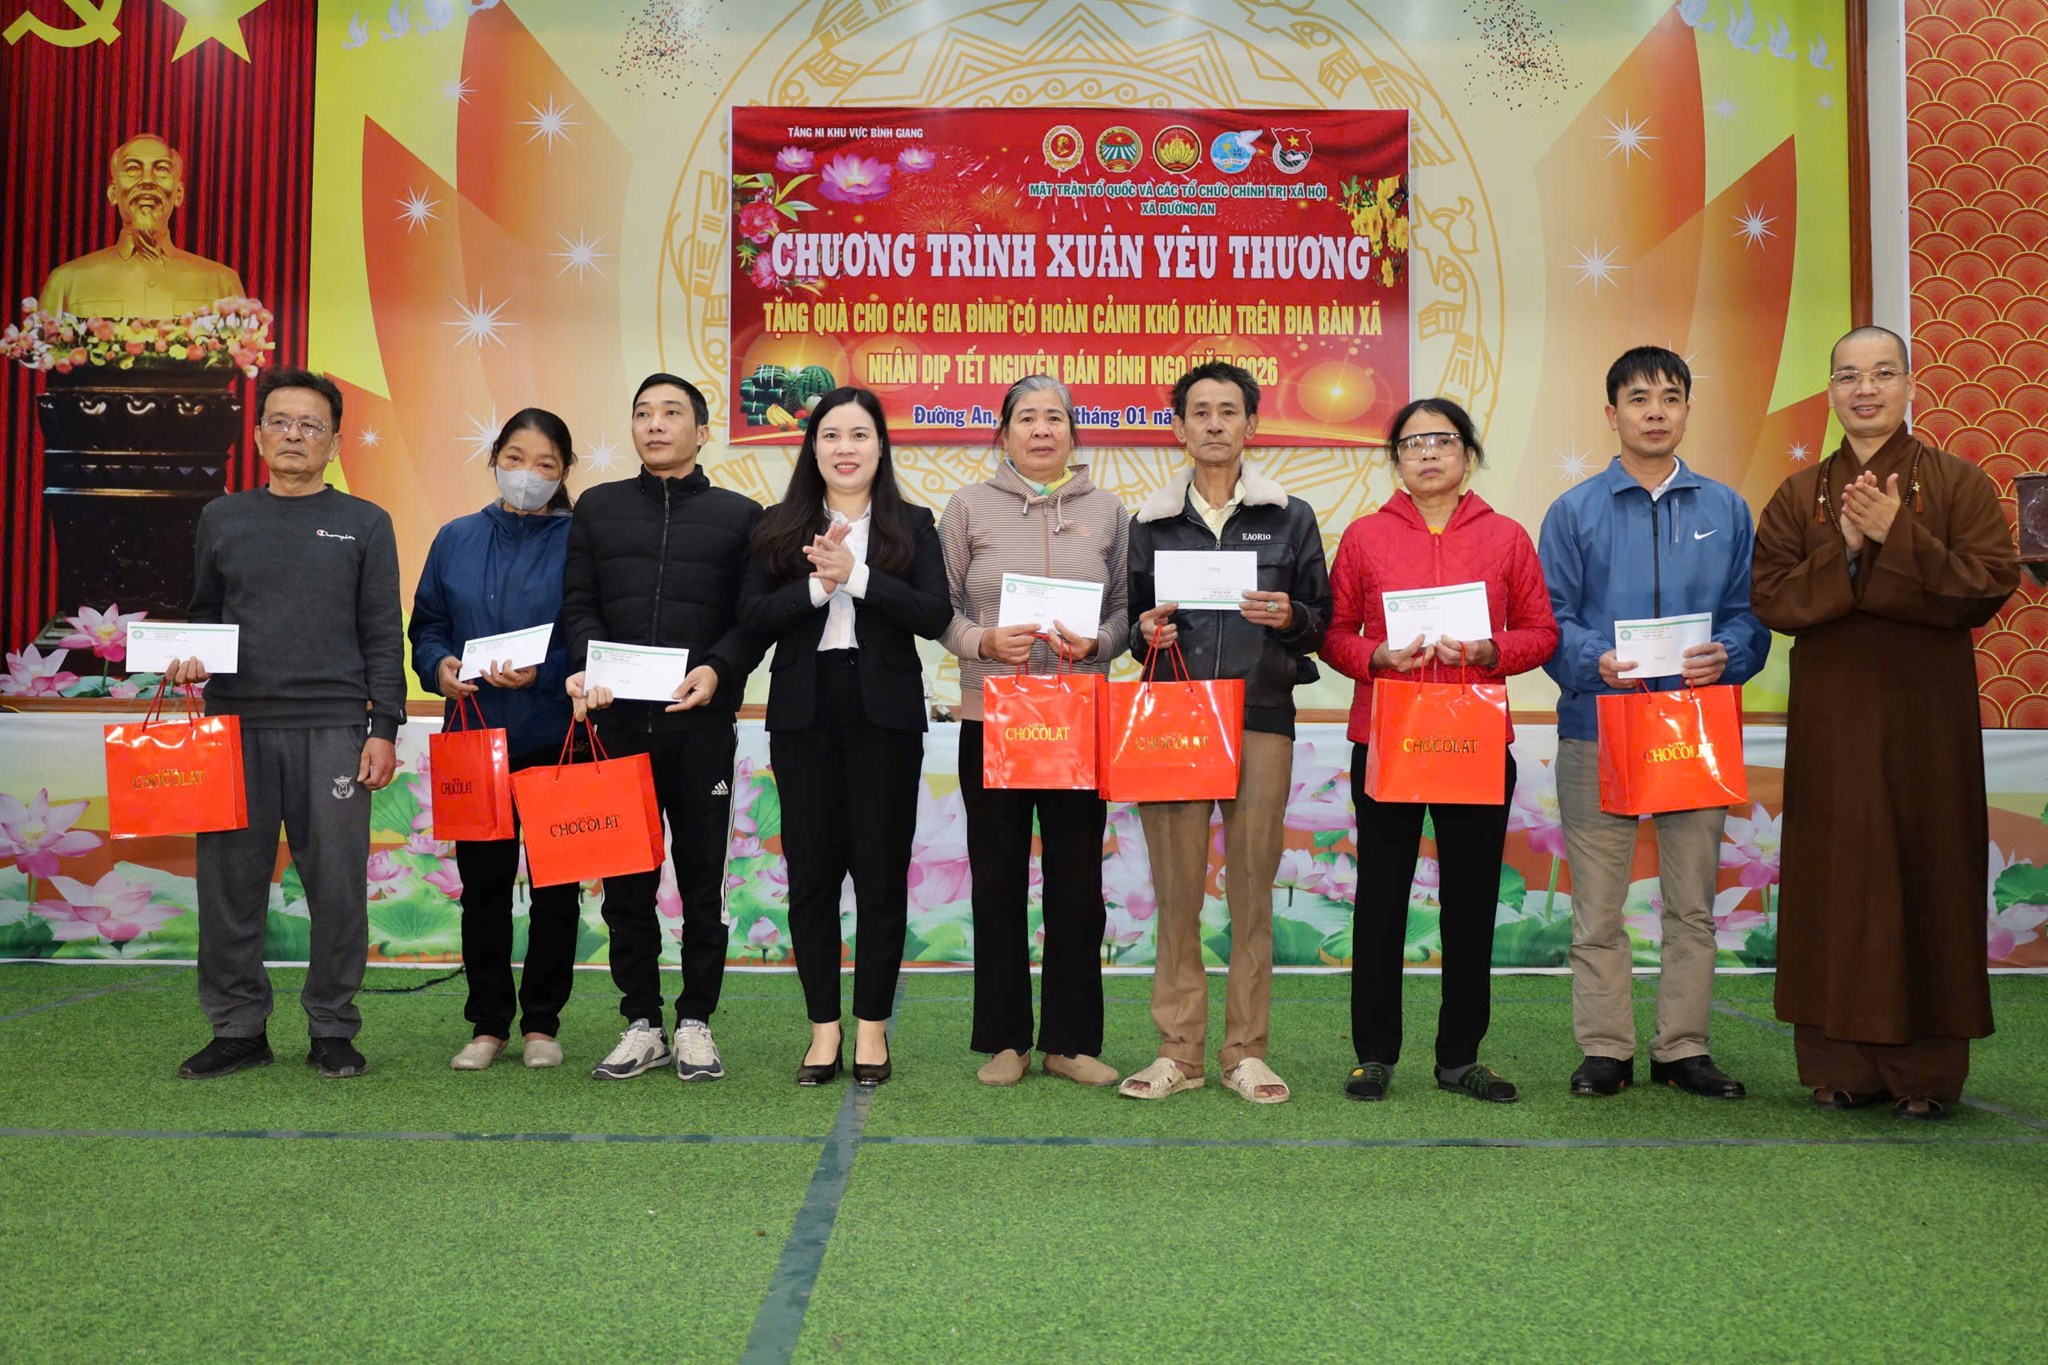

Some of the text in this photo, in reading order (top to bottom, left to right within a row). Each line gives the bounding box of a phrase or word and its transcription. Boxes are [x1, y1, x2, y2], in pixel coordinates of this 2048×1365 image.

[788, 125, 923, 140] TĂNG NI KHU VỰC BÌNH GIANG
[1055, 181, 1086, 199] TRẬN
[1088, 178, 1105, 196] TỔ
[1106, 179, 1136, 198] QUỐC
[1138, 181, 1155, 197] VÀ
[1155, 181, 1180, 197] CÁC
[1181, 179, 1197, 197] TỔ
[1198, 182, 1229, 197] CHỨC
[1231, 182, 1266, 197] CHÍNH
[1268, 184, 1287, 199] TRỊ
[1290, 183, 1305, 198] XÃ
[1307, 183, 1328, 199] HỘI
[1140, 200, 1216, 216] XÃ ĐƯỜNG AN
[772, 223, 1370, 280] CHƯƠNG TRÌNH XUÂN YÊU THƯƠNG
[763, 294, 1382, 340] TẶNG QUÀ CHO CÁC GIA ĐÌNH CÓ HOÀN CẢNH KHÓ KHĂN TRÊN ĐỊA BÀN XÃ
[868, 348, 917, 384] NHÂN
[922, 354, 950, 390] DỊP
[955, 345, 985, 384] TẾT
[990, 349, 1059, 384] NGUYÊN
[1063, 349, 1099, 384] ĐÁN
[1104, 349, 1146, 384] BÍNH
[913, 405, 998, 428] Đường An,
[1075, 405, 1120, 428] tháng
[1126, 405, 1147, 426] 01
[1004, 726, 1071, 741] CHOCOLAT
[1403, 738, 1478, 753] CHOCOLAT
[549, 814, 620, 838] CHOCOLAT
